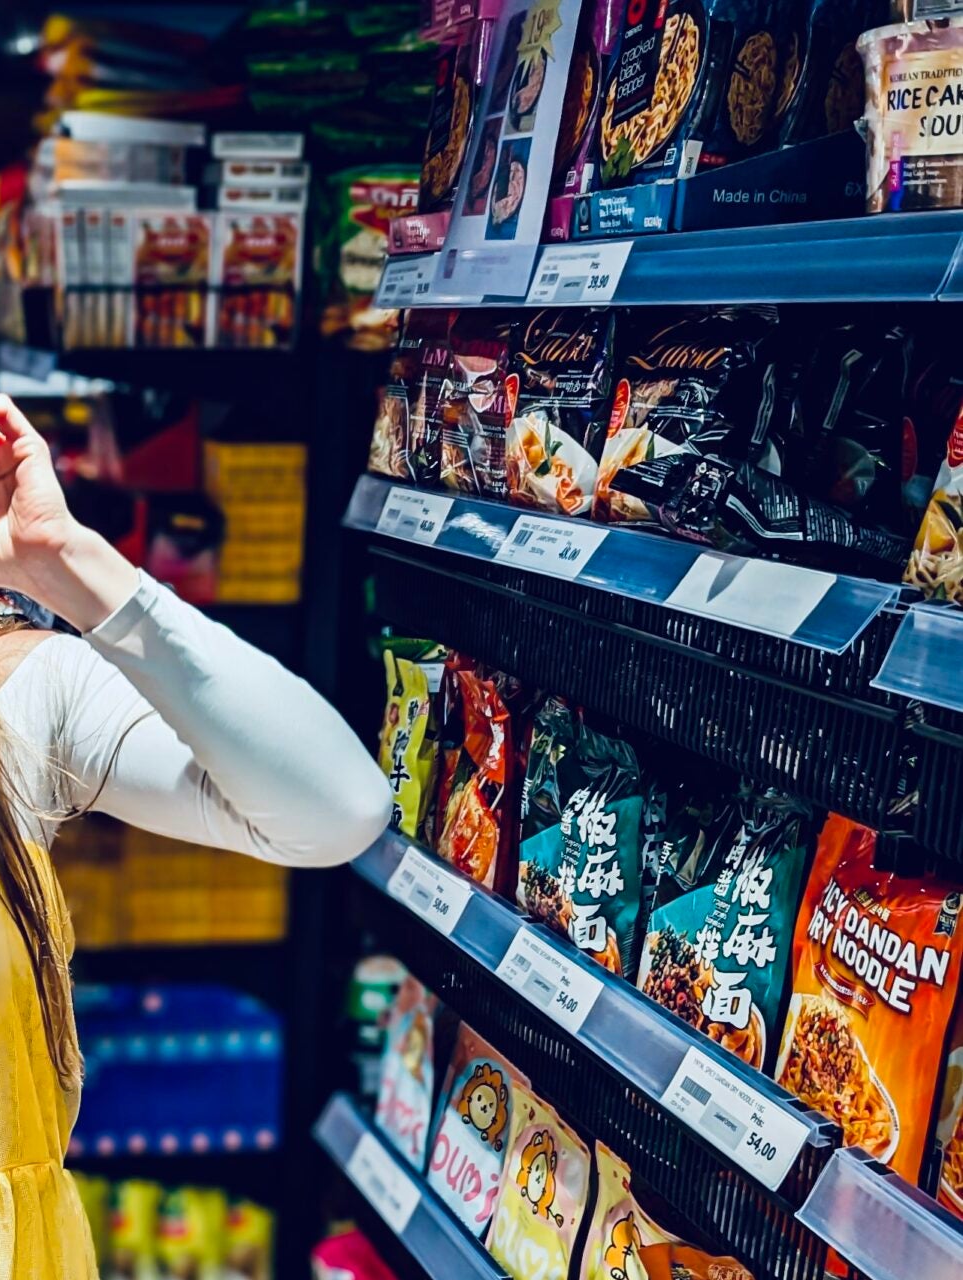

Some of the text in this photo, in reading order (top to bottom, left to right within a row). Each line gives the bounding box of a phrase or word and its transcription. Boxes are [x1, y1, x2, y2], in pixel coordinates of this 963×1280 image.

[622, 34, 655, 65] cracked
[619, 58, 642, 82] black
[890, 72, 919, 83] KOREAN
[617, 73, 646, 101] pepper
[888, 88, 921, 111] RICE
[713, 189, 807, 204] Made in China
[586, 273, 610, 288] 39,90
[845, 906, 950, 986] DANDAN
[833, 929, 916, 1012] NOODLE
[555, 990, 579, 1012] 54,00
[750, 1111, 766, 1126] Pris:
[745, 1131, 778, 1161] 54,00
